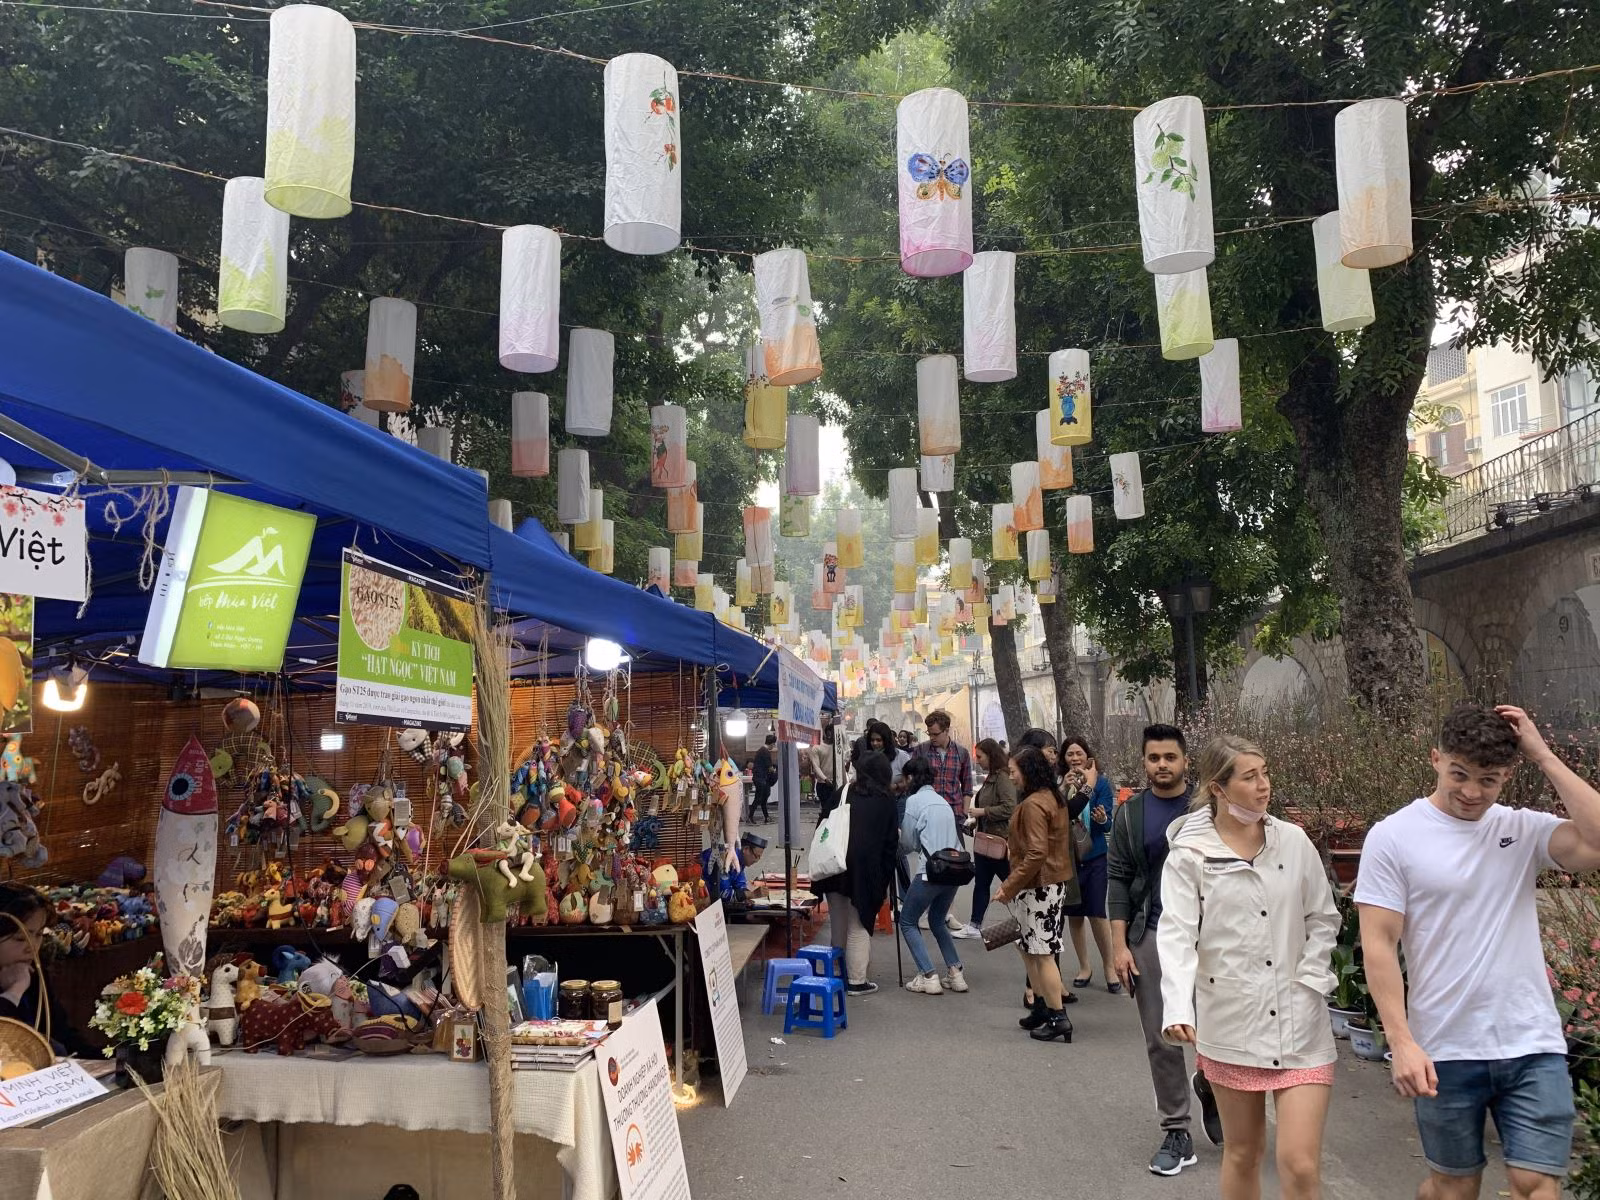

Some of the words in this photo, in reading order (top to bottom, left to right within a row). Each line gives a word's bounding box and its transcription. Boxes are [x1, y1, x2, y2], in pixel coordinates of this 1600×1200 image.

[0, 525, 65, 570] Việt
[252, 592, 278, 612] Việt
[424, 641, 440, 661] TÍCH
[420, 664, 438, 685] VIỆT
[441, 668, 456, 687] NAM
[2, 1076, 42, 1093] MINH
[17, 1076, 86, 1105] ACADEMY
